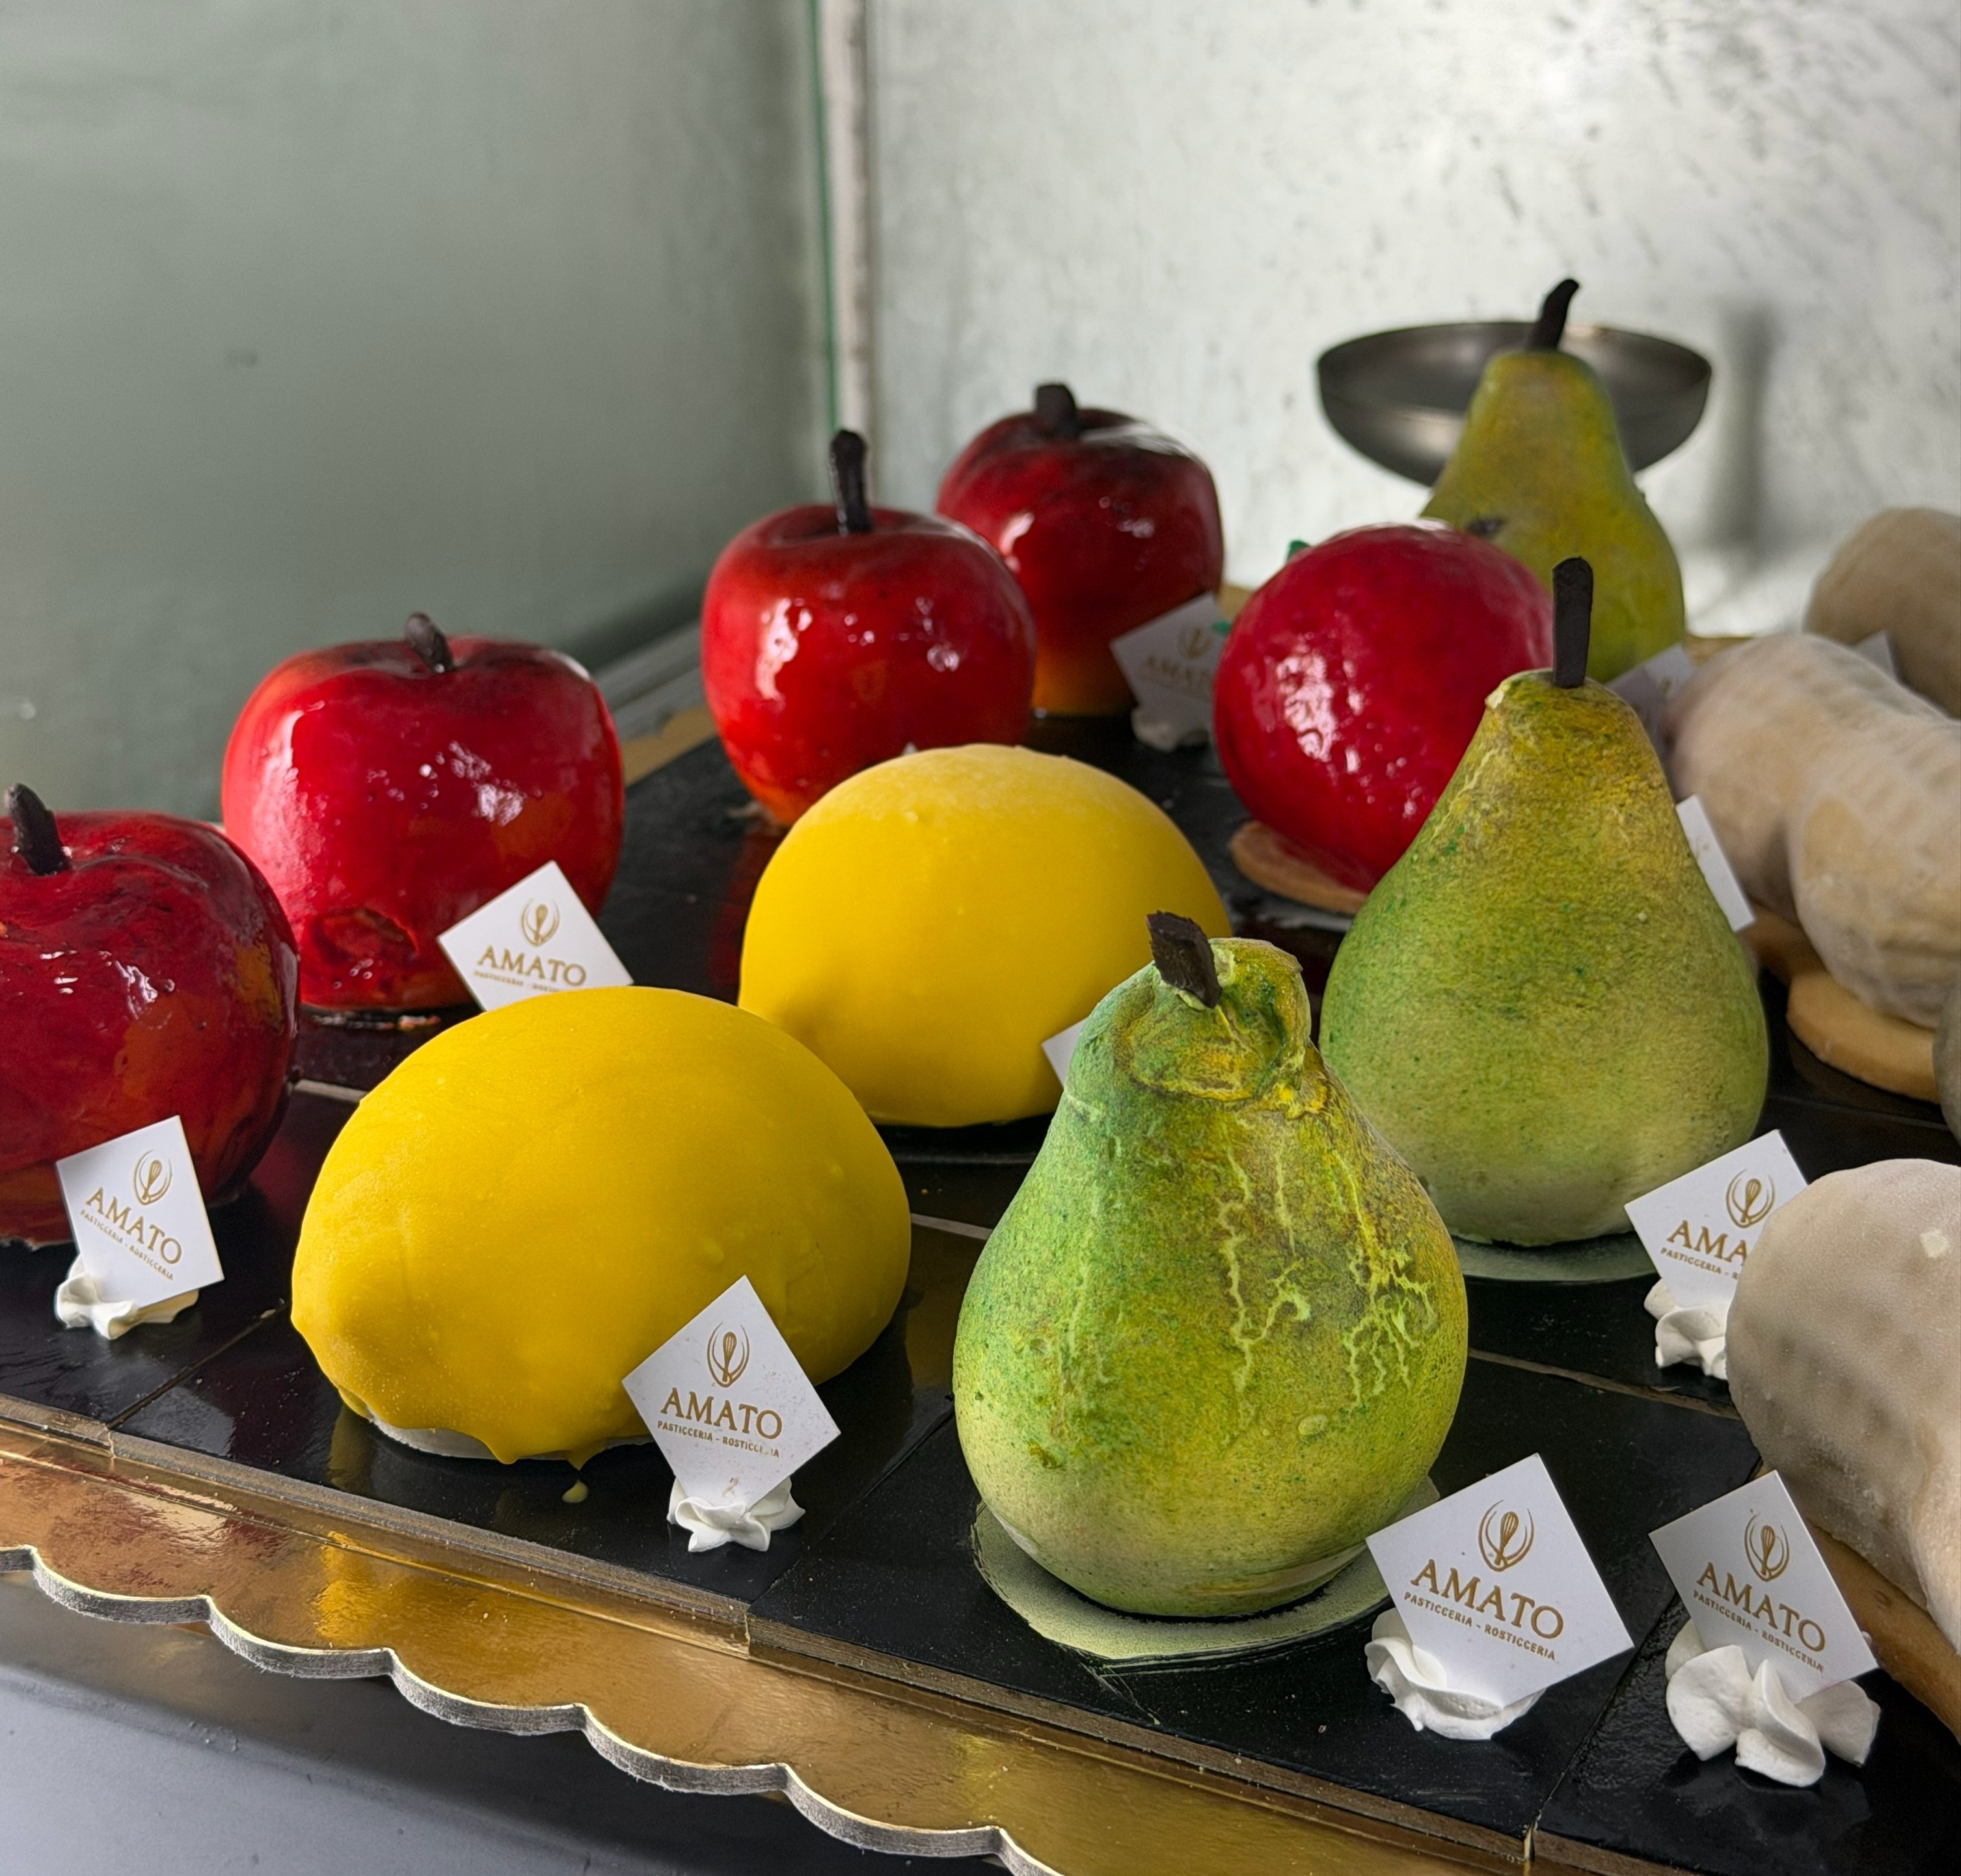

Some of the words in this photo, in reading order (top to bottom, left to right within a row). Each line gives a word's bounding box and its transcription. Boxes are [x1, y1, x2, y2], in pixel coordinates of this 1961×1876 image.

[477, 944, 586, 986] AMATO
[86, 1186, 182, 1264] AMATO
[1666, 1219, 1747, 1267] AMA
[1661, 1247, 1721, 1274] PASTICCERIA
[657, 1421, 713, 1442] PASTICCERIA
[660, 1387, 783, 1439] AMATO
[1403, 1592, 1472, 1627] PASTICCERIA
[1484, 1624, 1555, 1661] ROSTICCERIA
[1410, 1558, 1563, 1639] AMATO
[1696, 1562, 1826, 1652] AMATO
[1693, 1590, 1752, 1631] PASTICCERIA
[1761, 1629, 1824, 1672] ROSTICCERIA
